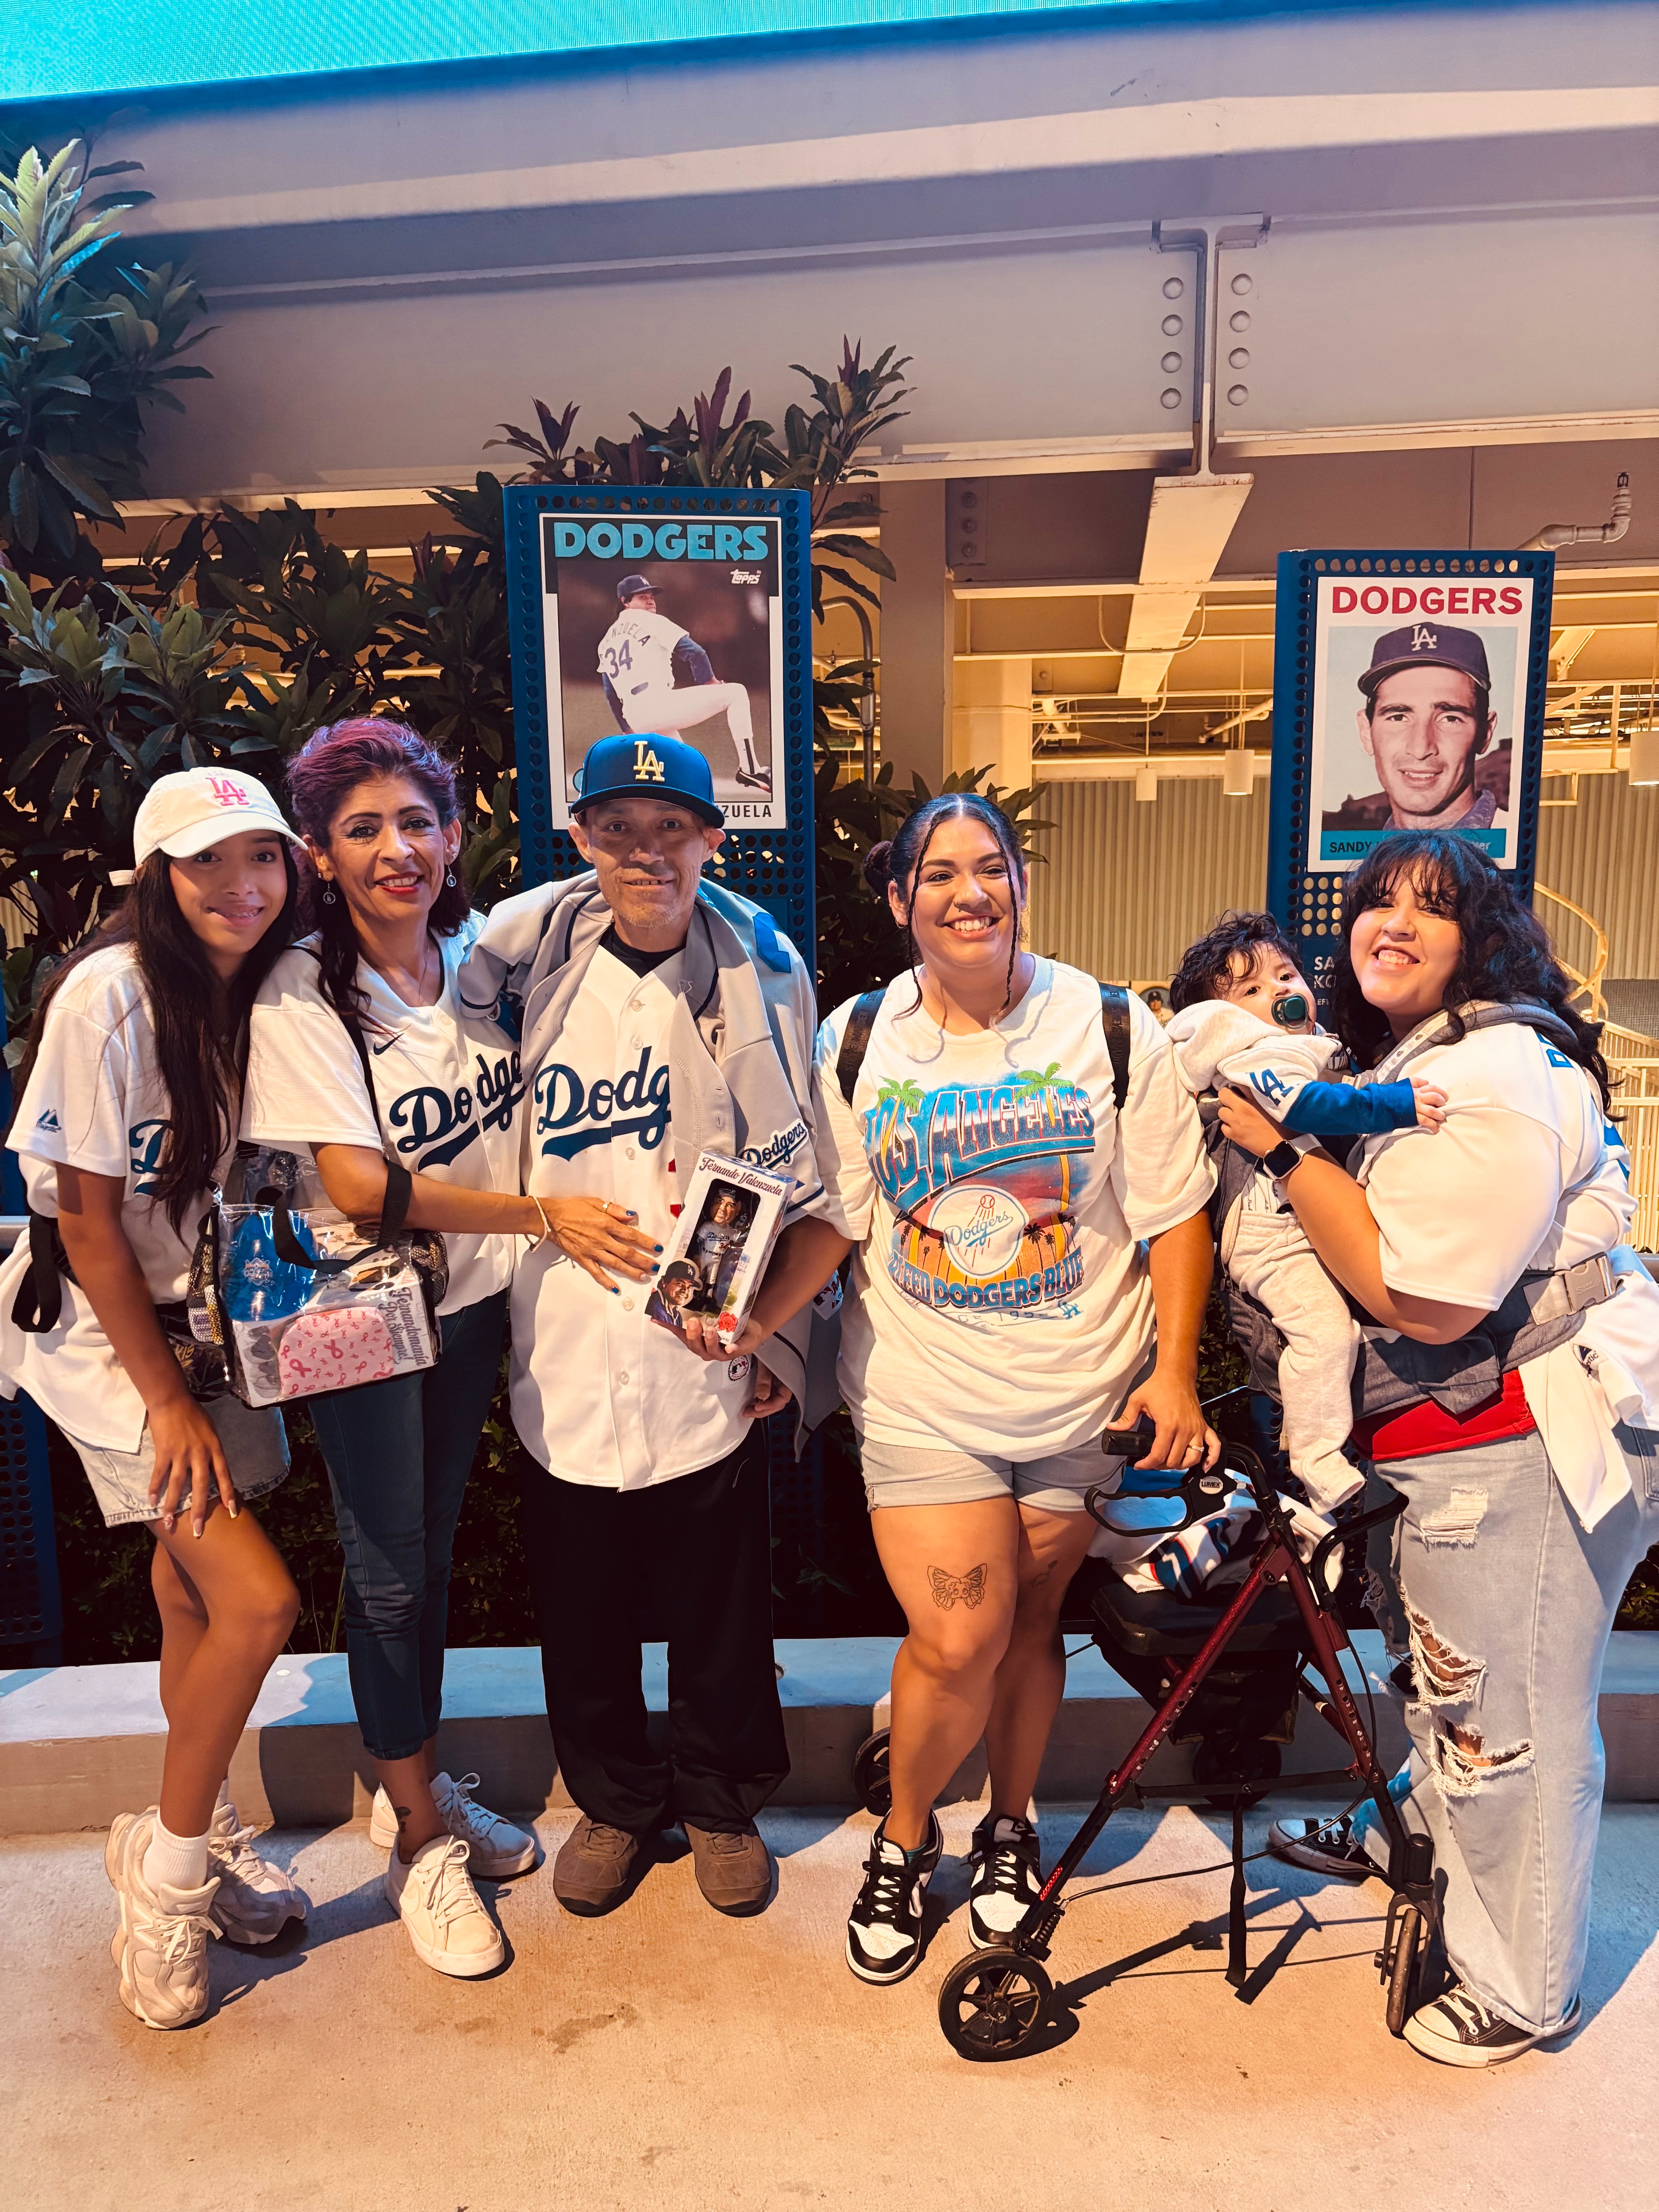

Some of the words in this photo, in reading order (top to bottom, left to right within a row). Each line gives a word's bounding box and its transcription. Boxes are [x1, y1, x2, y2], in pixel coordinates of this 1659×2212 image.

[553, 522, 769, 561] DODGERS
[1332, 586, 1523, 615] DODGERS
[1411, 625, 1437, 651] LA
[605, 639, 633, 678] 34
[633, 741, 665, 782] LA
[206, 777, 250, 806] LA
[723, 805, 772, 818] ZUELA
[1329, 841, 1372, 853] SANDY
[389, 1051, 523, 1153] Dodge
[535, 1046, 671, 1150] Dodg
[1246, 1069, 1295, 1106] LA
[737, 1123, 807, 1165] Dodgers
[867, 1097, 922, 1201] OS
[929, 1084, 1096, 1192] ANGELES
[699, 1157, 740, 1180] Fernando
[738, 1172, 783, 1196] Valenzuela
[944, 1211, 1012, 1246] Dodgers
[687, 1265, 693, 1276] LA
[933, 1273, 1042, 1308] DODGERS
[1044, 1246, 1084, 1301] BLUE
[378, 1301, 398, 1321] Por
[389, 1287, 429, 1366] Fernandomanía
[1586, 1352, 1599, 1368] stic
